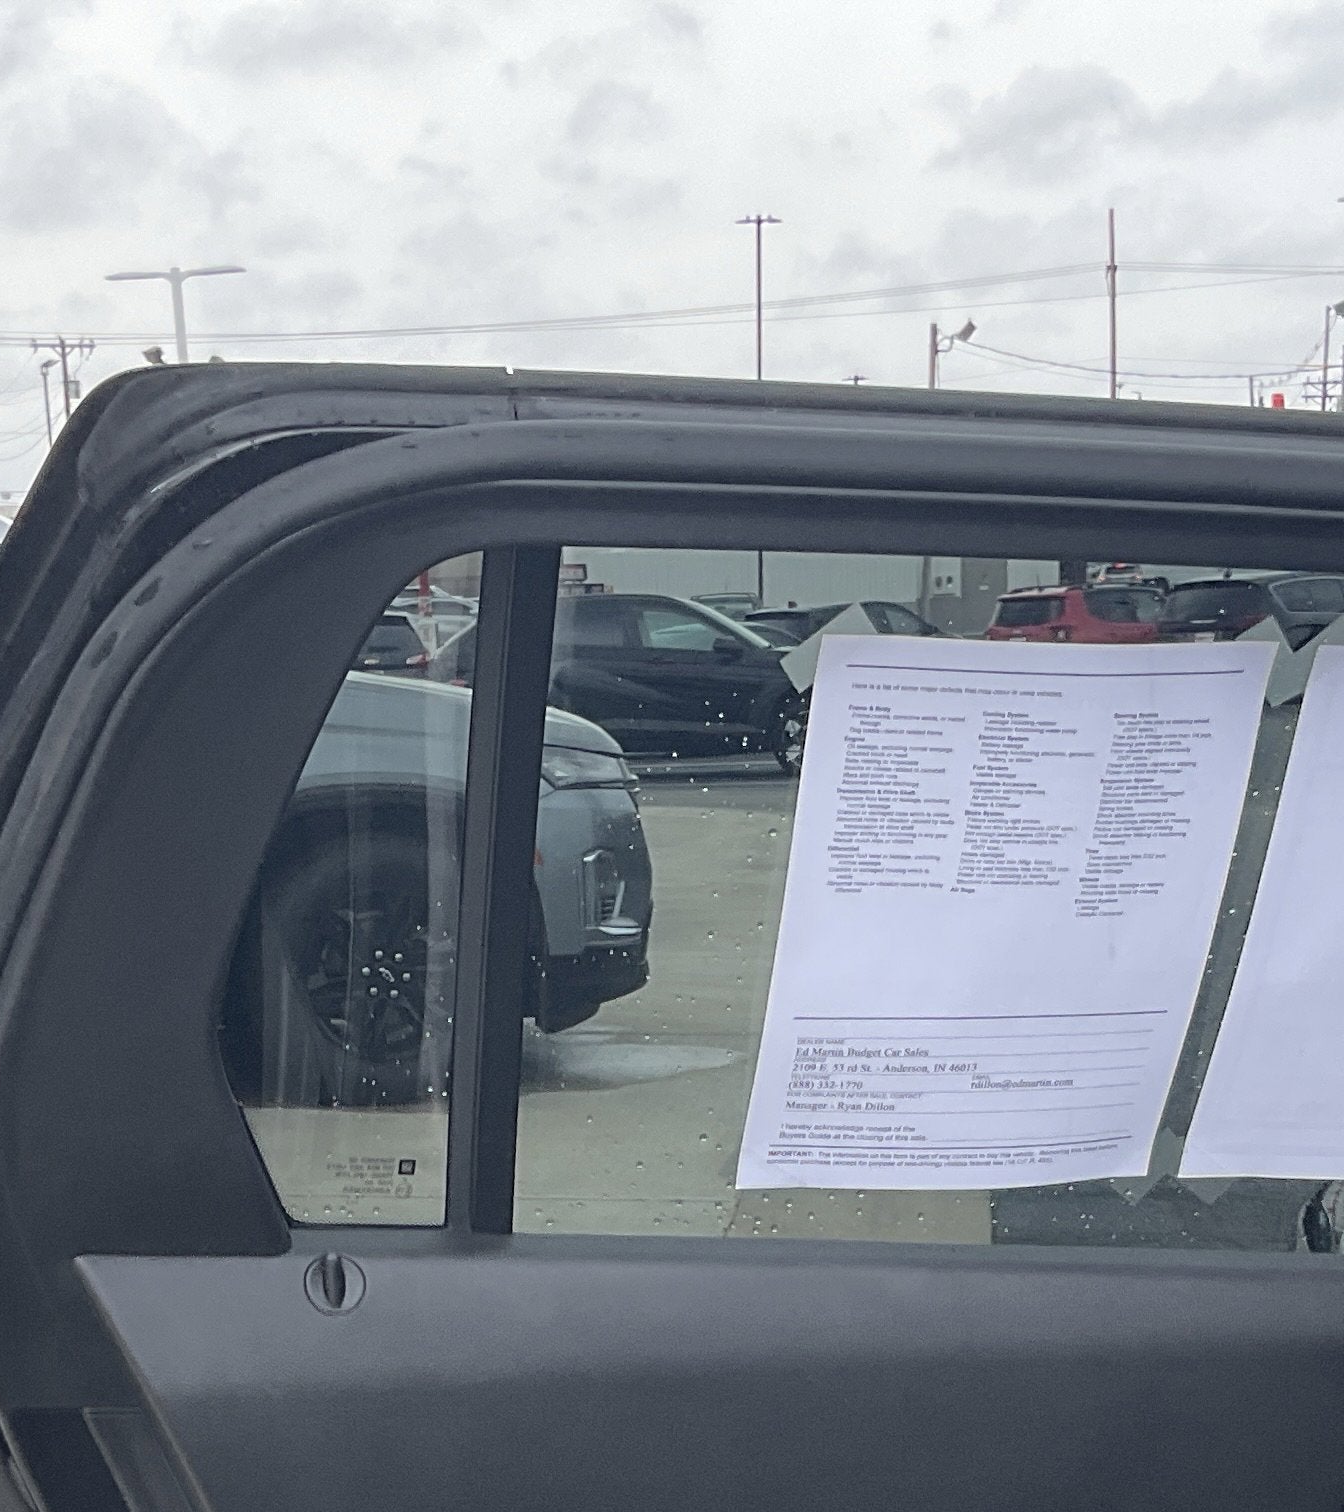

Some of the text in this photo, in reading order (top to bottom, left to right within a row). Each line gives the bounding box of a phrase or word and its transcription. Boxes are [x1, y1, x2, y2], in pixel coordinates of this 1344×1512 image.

[796, 1047, 929, 1058] Ed Martin Budget Car Sales
[792, 1063, 817, 1072] 2109
[882, 1063, 930, 1073] Anderson,
[934, 1063, 946, 1072] IN
[949, 1063, 977, 1072] 46013
[785, 1102, 828, 1112] Manager
[837, 1102, 862, 1112] Ryan
[865, 1102, 895, 1111] Dillon
